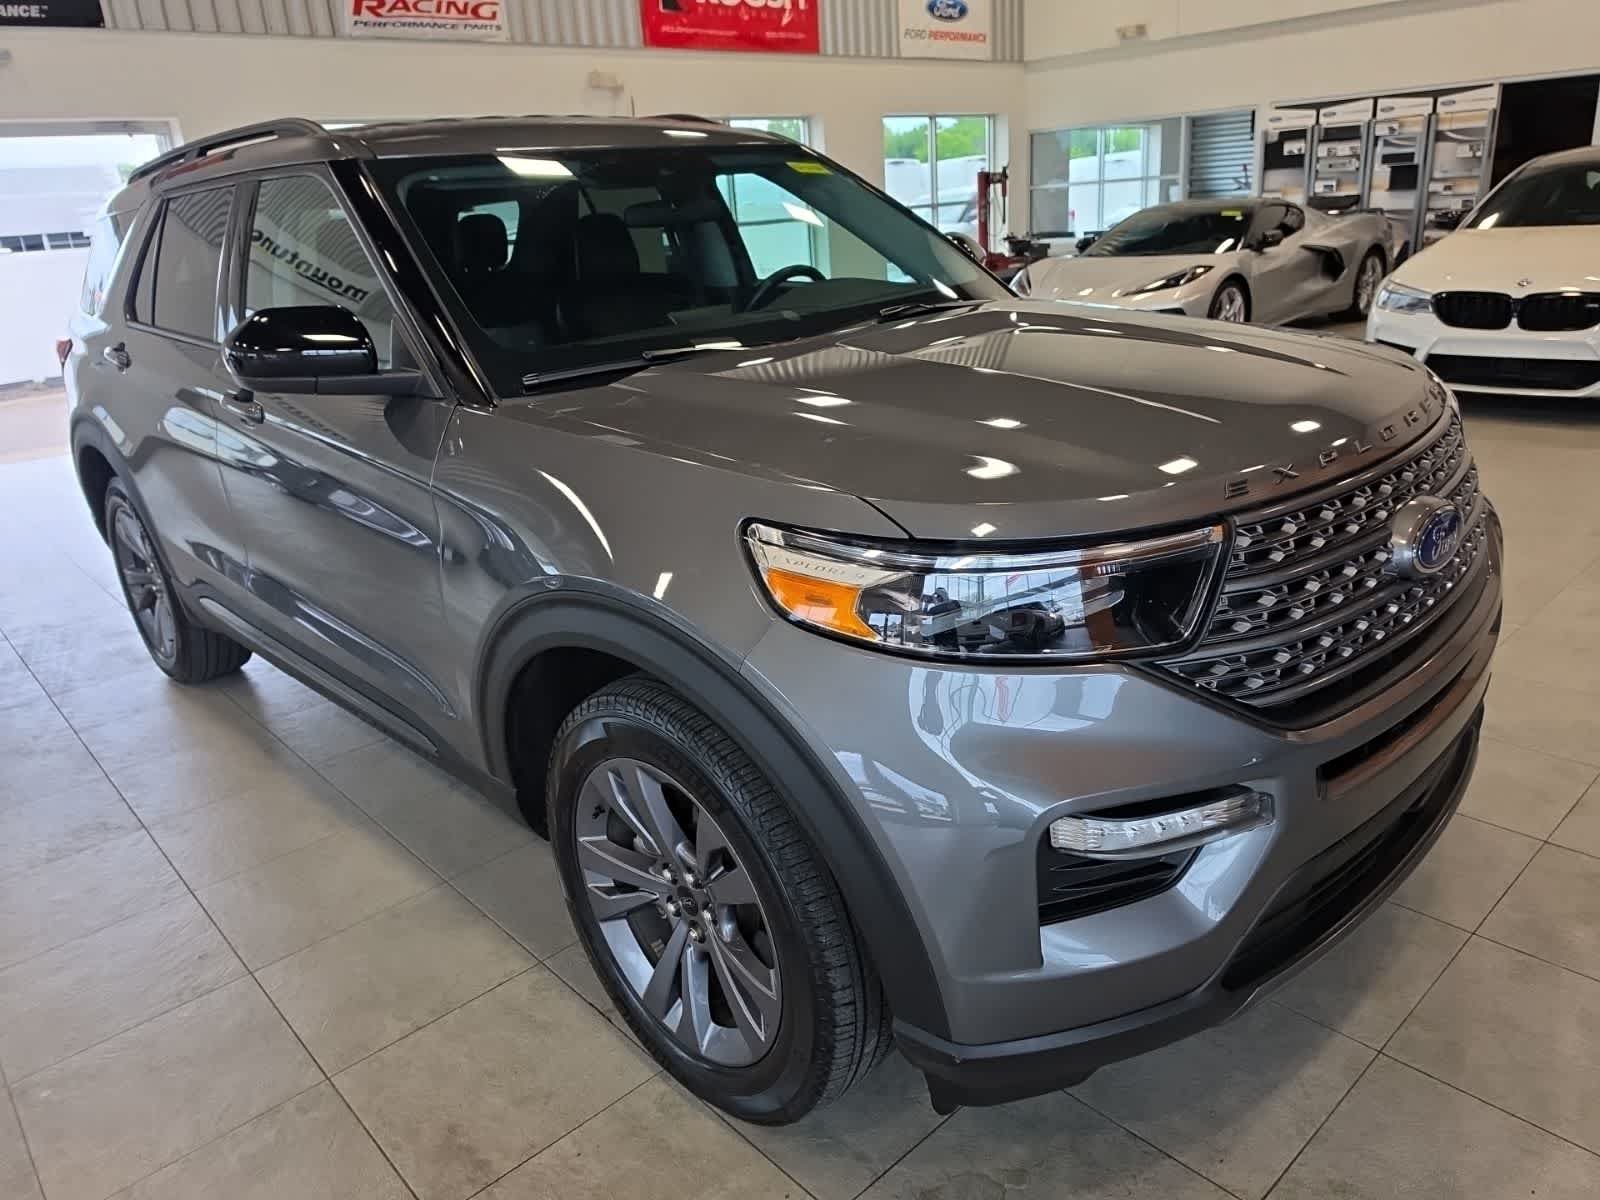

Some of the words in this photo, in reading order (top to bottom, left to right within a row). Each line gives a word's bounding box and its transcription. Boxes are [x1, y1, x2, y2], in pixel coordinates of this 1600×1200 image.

[352, 0, 498, 20] RACING
[353, 20, 458, 30] PERFORMANCE
[463, 23, 503, 31] PARTS
[904, 28, 927, 40] FORD
[1224, 381, 1445, 498] EXPLORER
